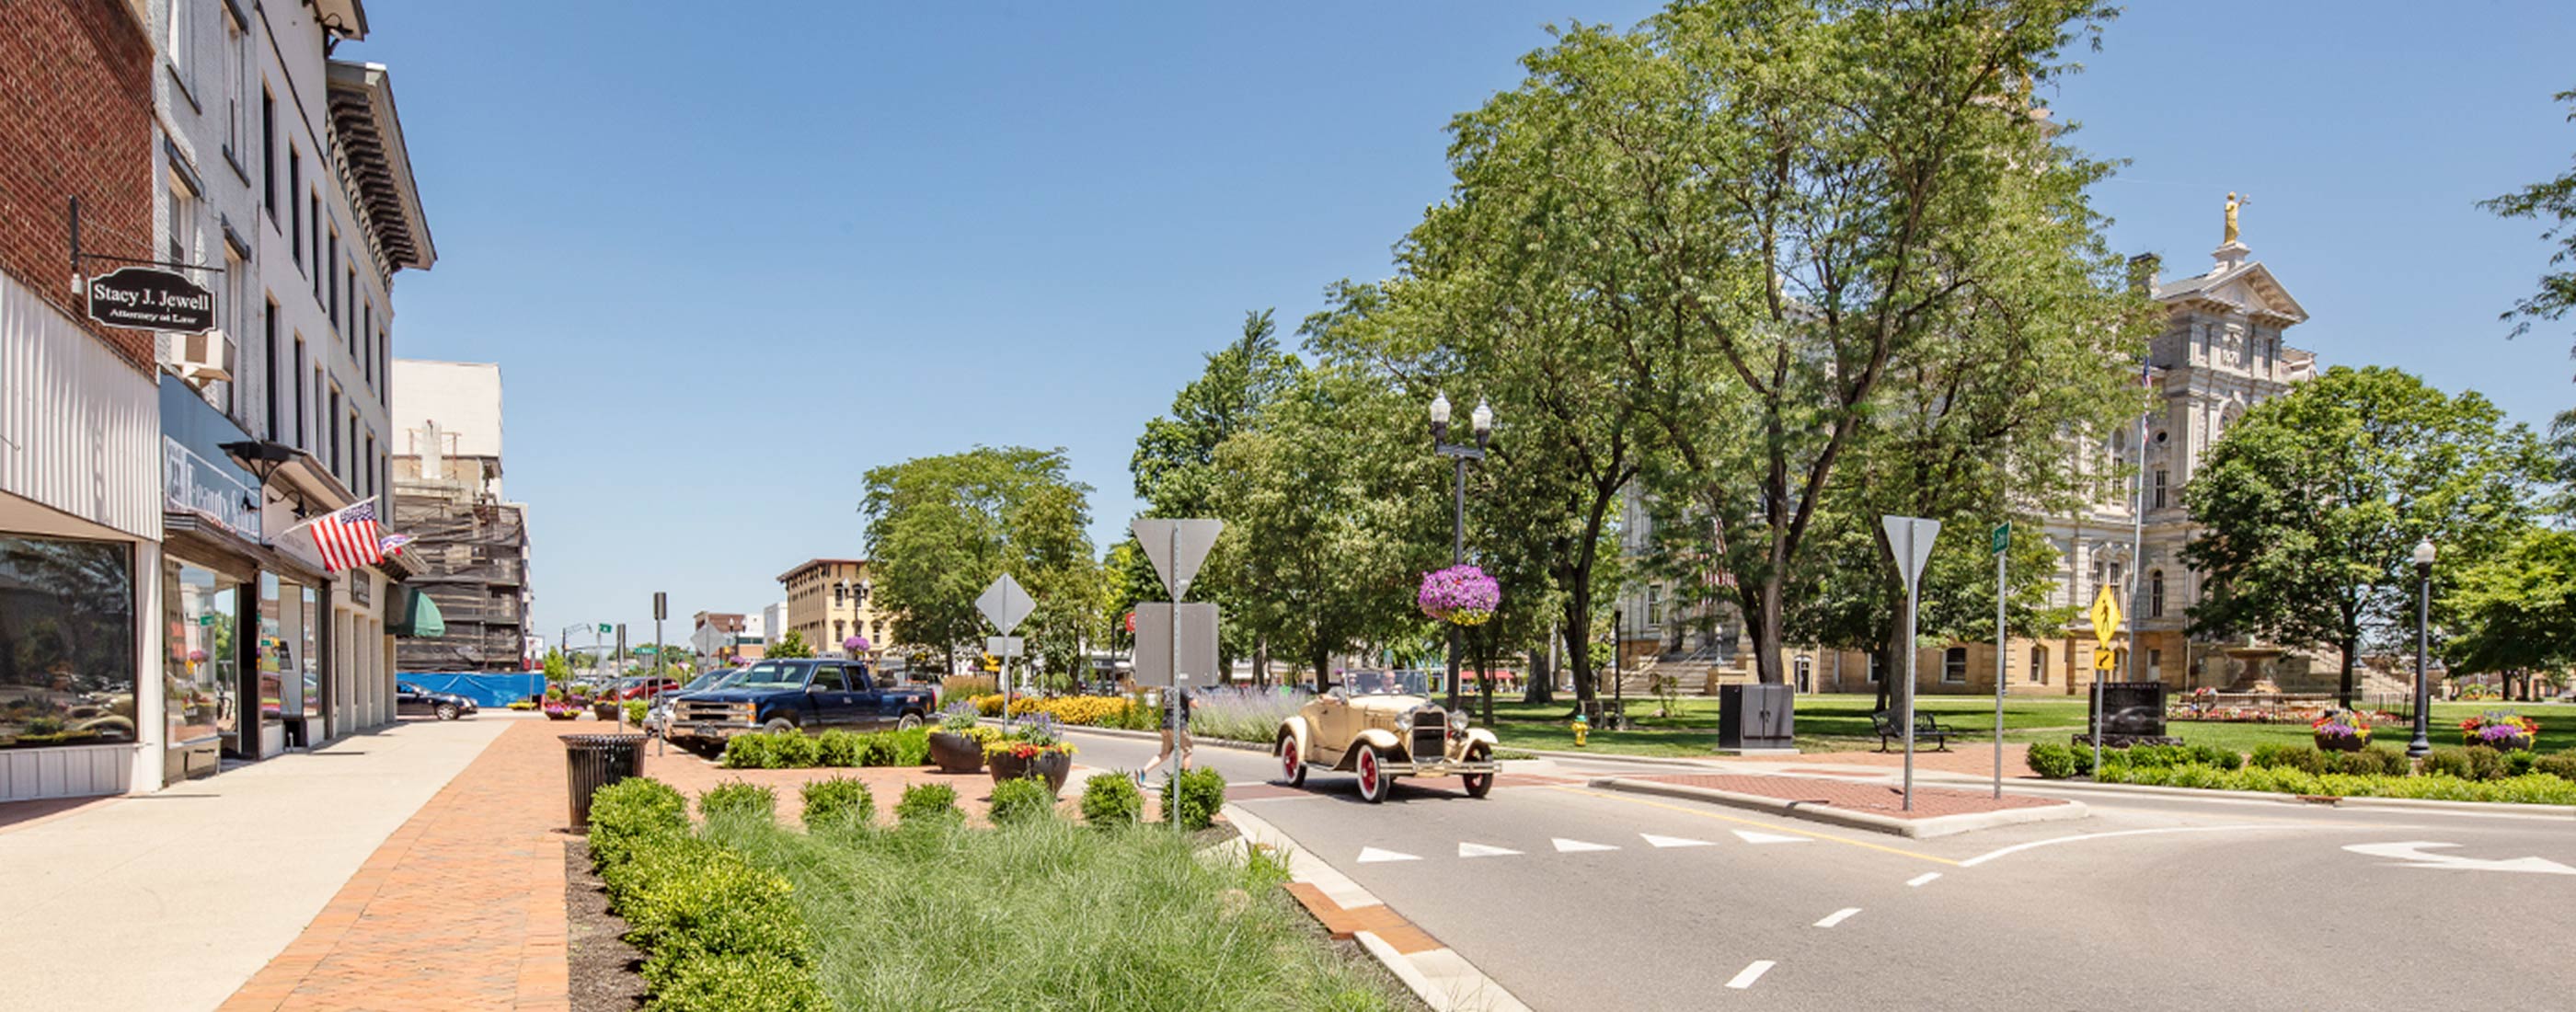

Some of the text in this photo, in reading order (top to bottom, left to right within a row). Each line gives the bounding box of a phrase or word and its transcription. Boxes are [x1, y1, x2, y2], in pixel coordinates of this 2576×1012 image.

[94, 283, 210, 311] Stacy J. Jewell
[109, 308, 198, 324] Attorney at Law
